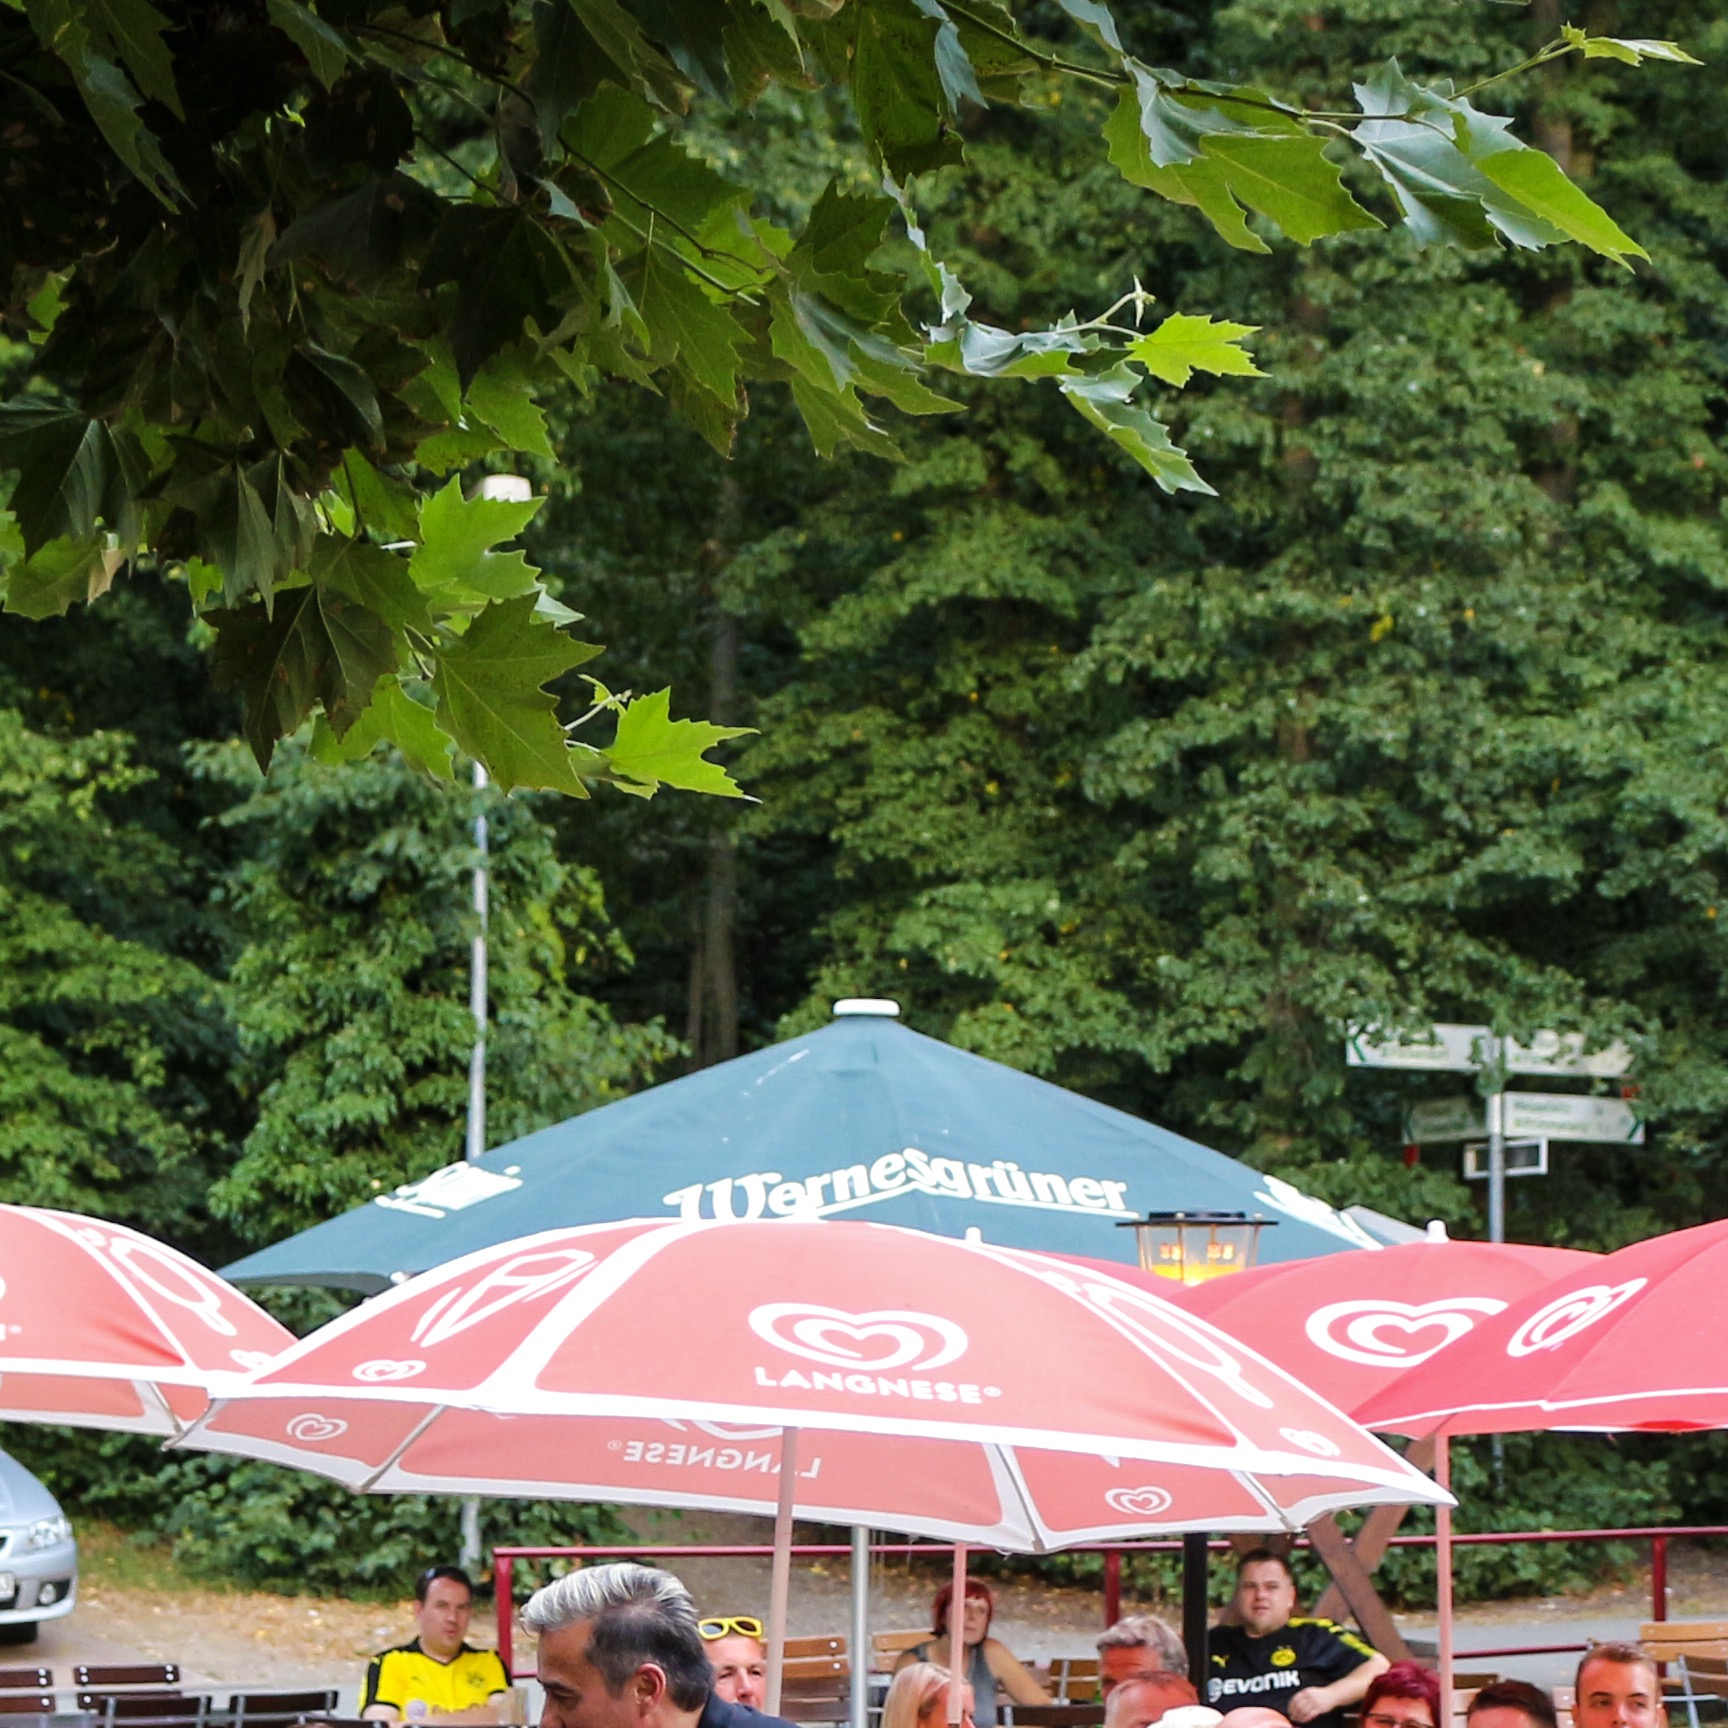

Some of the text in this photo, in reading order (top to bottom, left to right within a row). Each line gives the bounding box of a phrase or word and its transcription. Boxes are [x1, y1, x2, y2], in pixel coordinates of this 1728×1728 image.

[663, 1147, 1129, 1220] Wernesgrüner
[754, 1366, 983, 1404] LANGNESE
[1223, 1670, 1301, 1695] EVONIK
